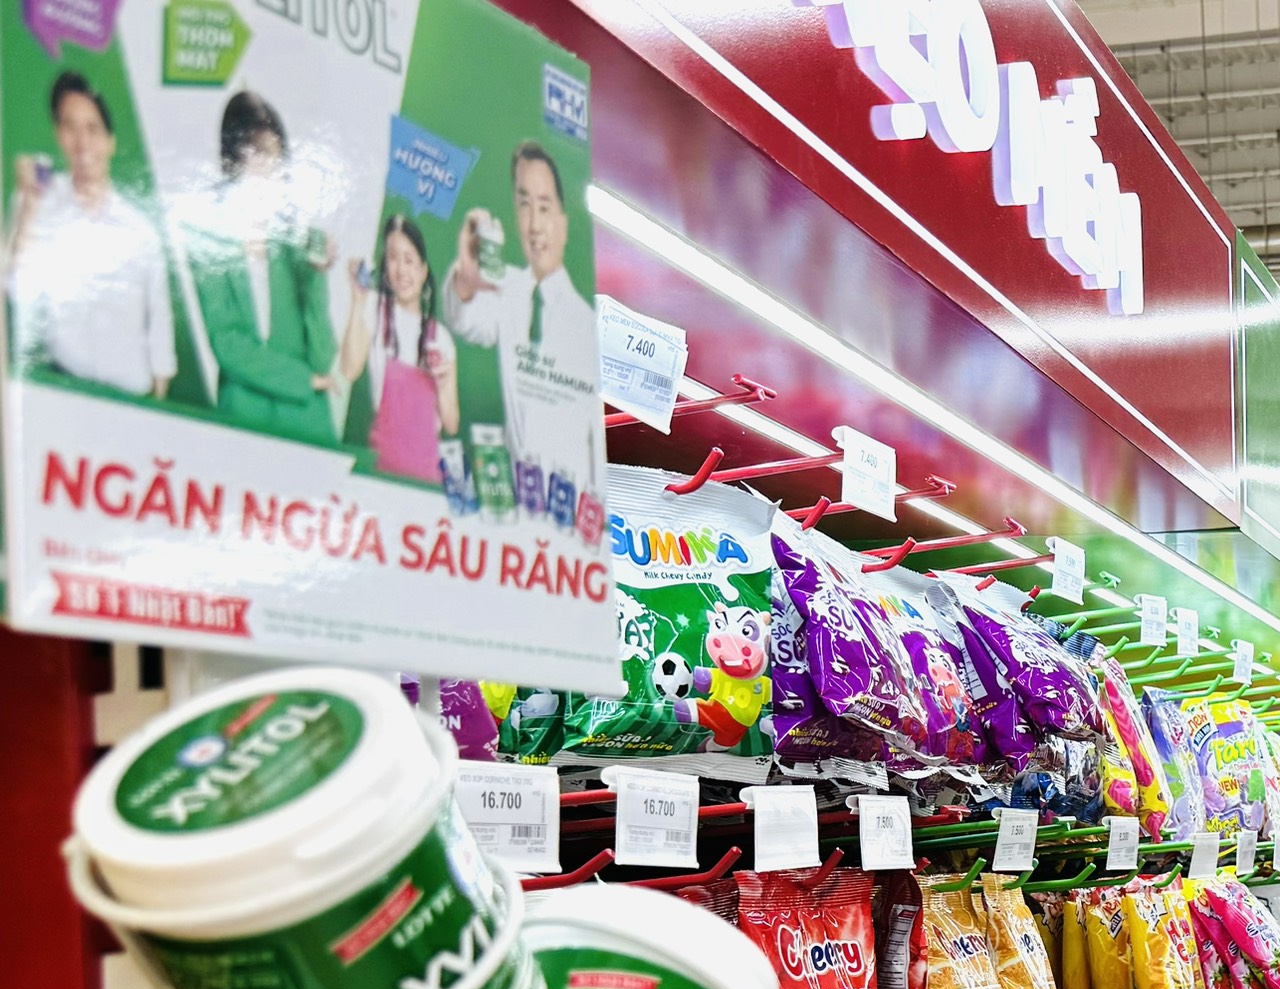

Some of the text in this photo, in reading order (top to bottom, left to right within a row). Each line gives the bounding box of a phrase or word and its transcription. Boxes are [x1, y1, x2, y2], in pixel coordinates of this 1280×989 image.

[626, 334, 656, 358] 7.400
[548, 369, 596, 396] HAMURA
[42, 450, 609, 603] NGĂN NGỪA SÂU RĂNG
[644, 571, 660, 580] Milk
[150, 700, 331, 826] XYLITOL
[480, 791, 522, 810] 16.700
[643, 798, 676, 817] 16.700
[876, 815, 894, 829] 7.500
